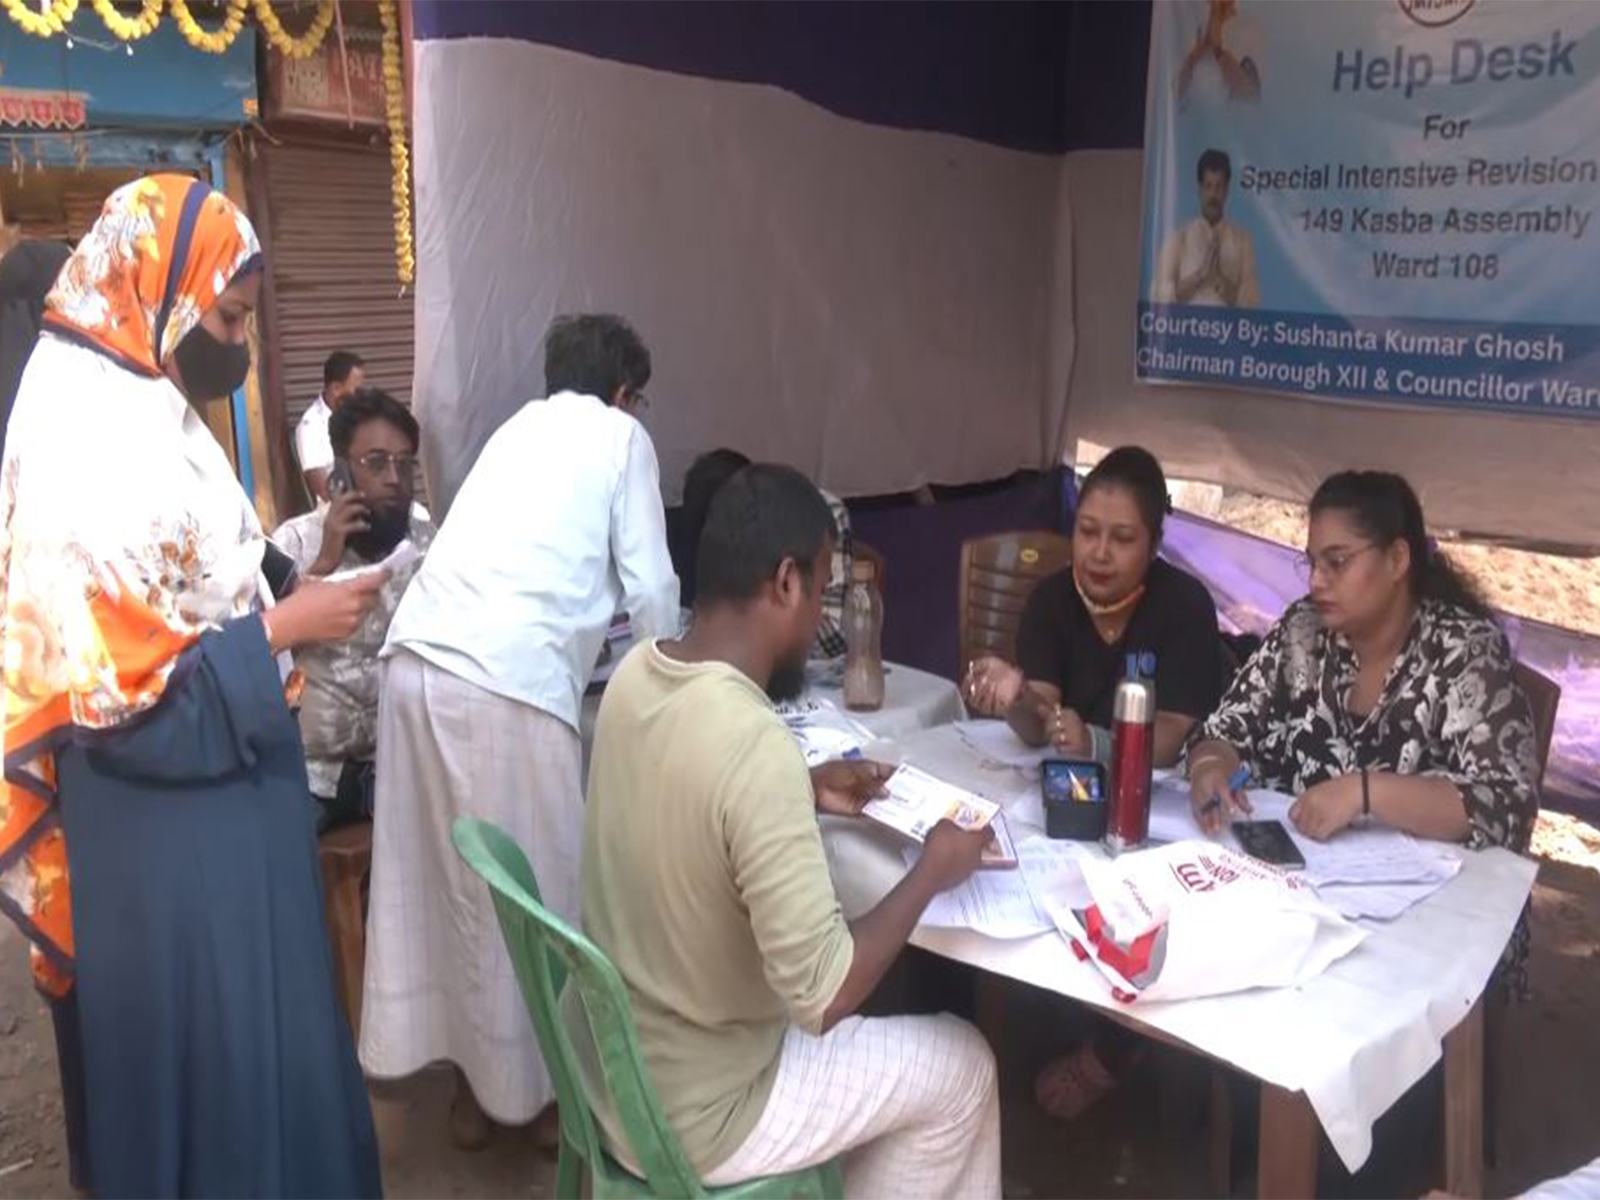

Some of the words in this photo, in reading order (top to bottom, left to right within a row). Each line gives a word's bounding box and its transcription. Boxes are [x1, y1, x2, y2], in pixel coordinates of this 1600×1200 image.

[1332, 46, 1433, 98] Help
[1450, 31, 1578, 85] Desk
[1422, 114, 1472, 140] For
[1240, 164, 1329, 193] Special
[1338, 161, 1458, 188] Intensive
[1467, 155, 1598, 186] Revision
[1301, 207, 1343, 232] 149
[1351, 206, 1434, 233] Kasba
[1443, 204, 1591, 239] Assembly
[1372, 251, 1439, 279] Ward
[1452, 253, 1499, 280] 108
[1139, 312, 1233, 340] Courtesy
[1237, 322, 1269, 345] By:
[1273, 323, 1378, 352] Sushanta
[1385, 330, 1467, 357] Kumar
[1474, 333, 1564, 362] Ghosh
[1137, 347, 1235, 376] Chairman
[1240, 356, 1331, 390] Borough
[1337, 369, 1367, 389] XII
[1373, 370, 1390, 390] &
[1396, 369, 1535, 404] Councillor
[1541, 379, 1600, 408] War
